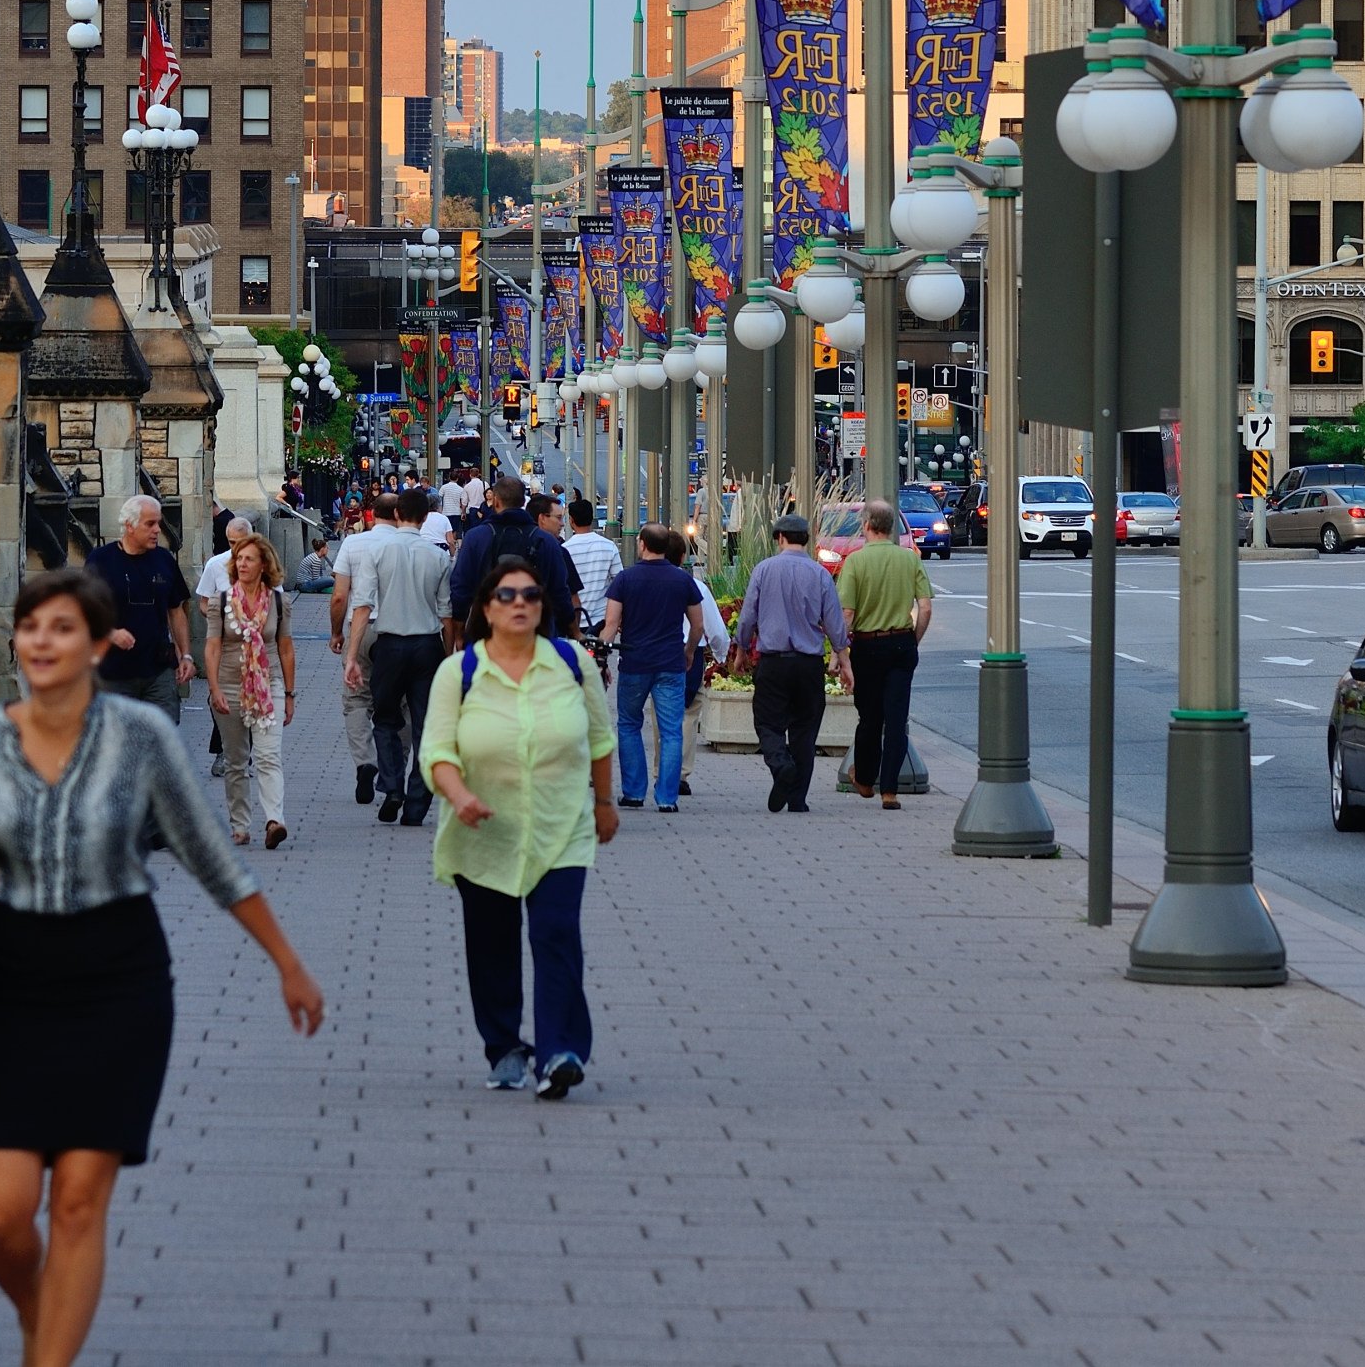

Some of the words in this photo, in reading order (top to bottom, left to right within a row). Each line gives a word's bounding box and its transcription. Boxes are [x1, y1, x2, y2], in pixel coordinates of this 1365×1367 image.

[664, 96, 673, 105] Le
[693, 96, 702, 105] de
[703, 97, 730, 105] diamant
[679, 107, 688, 115] de
[688, 107, 695, 115] la
[696, 107, 715, 115] Reine
[370, 394, 393, 402] Sussex
